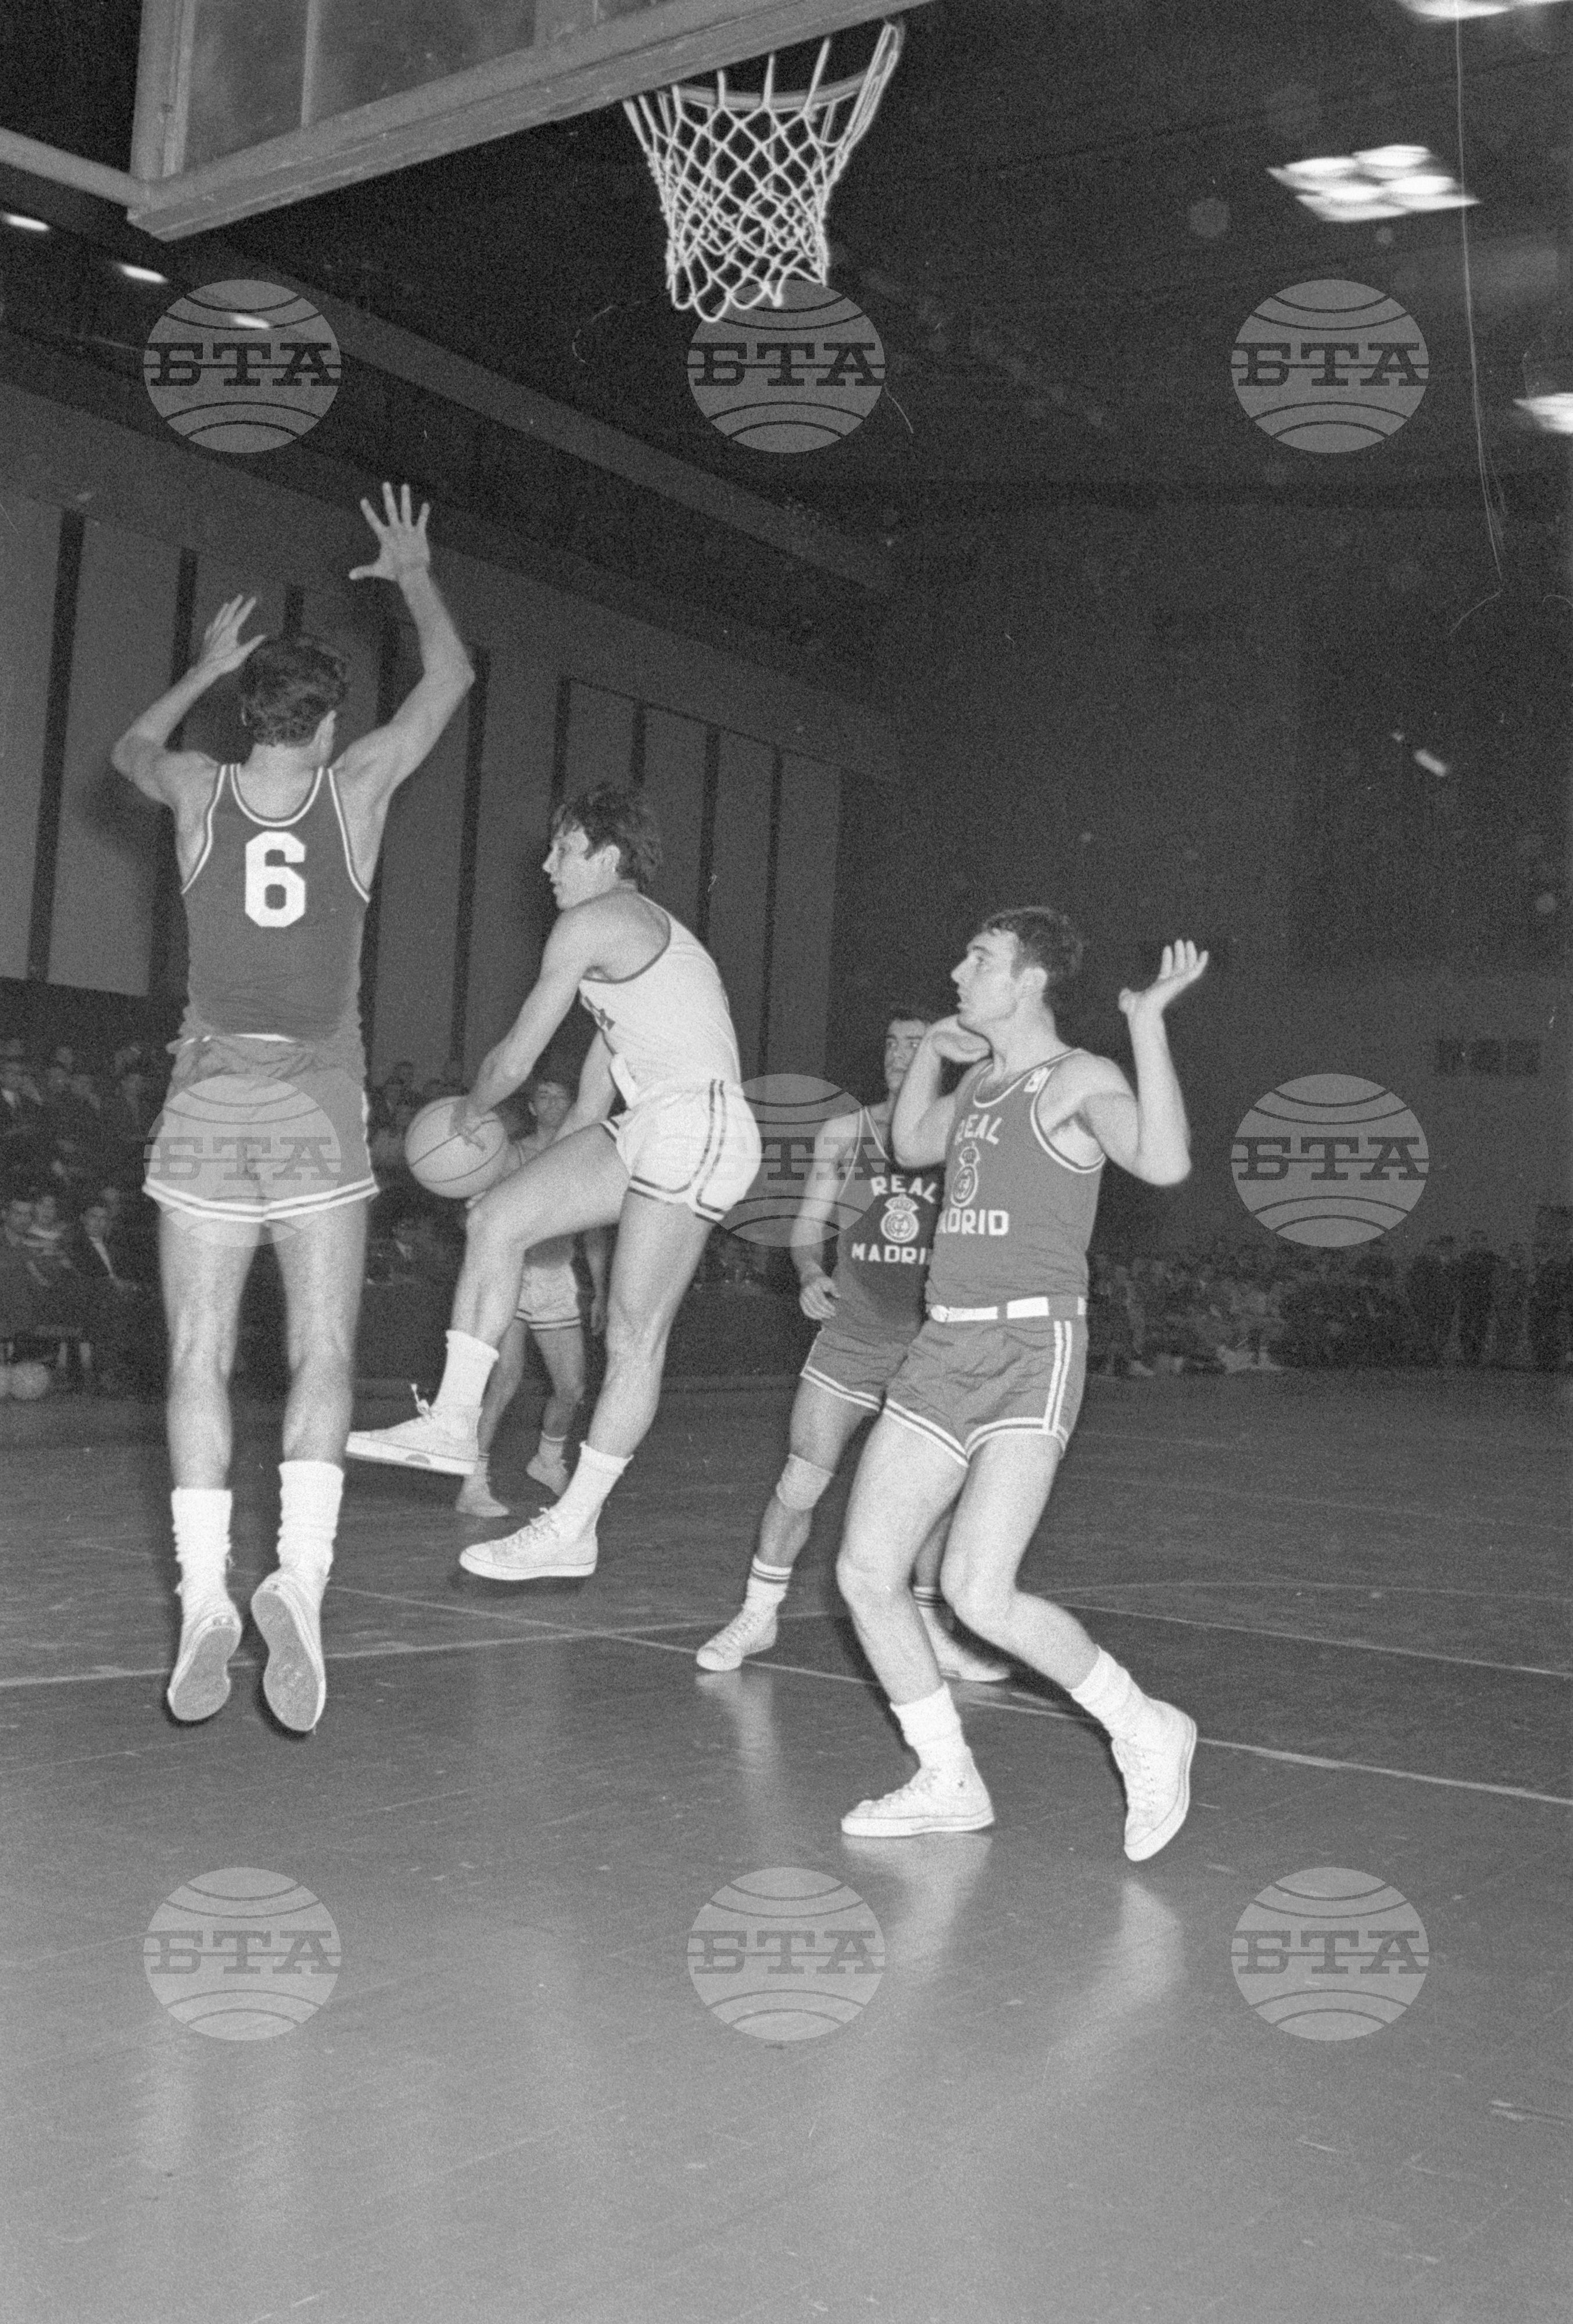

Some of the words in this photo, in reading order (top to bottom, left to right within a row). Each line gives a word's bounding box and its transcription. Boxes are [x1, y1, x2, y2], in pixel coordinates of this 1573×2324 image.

[245, 831, 306, 927] 6
[870, 1174, 937, 1204] REAL
[936, 1208, 1009, 1235] ADRID
[851, 1242, 932, 1265] MADRI
